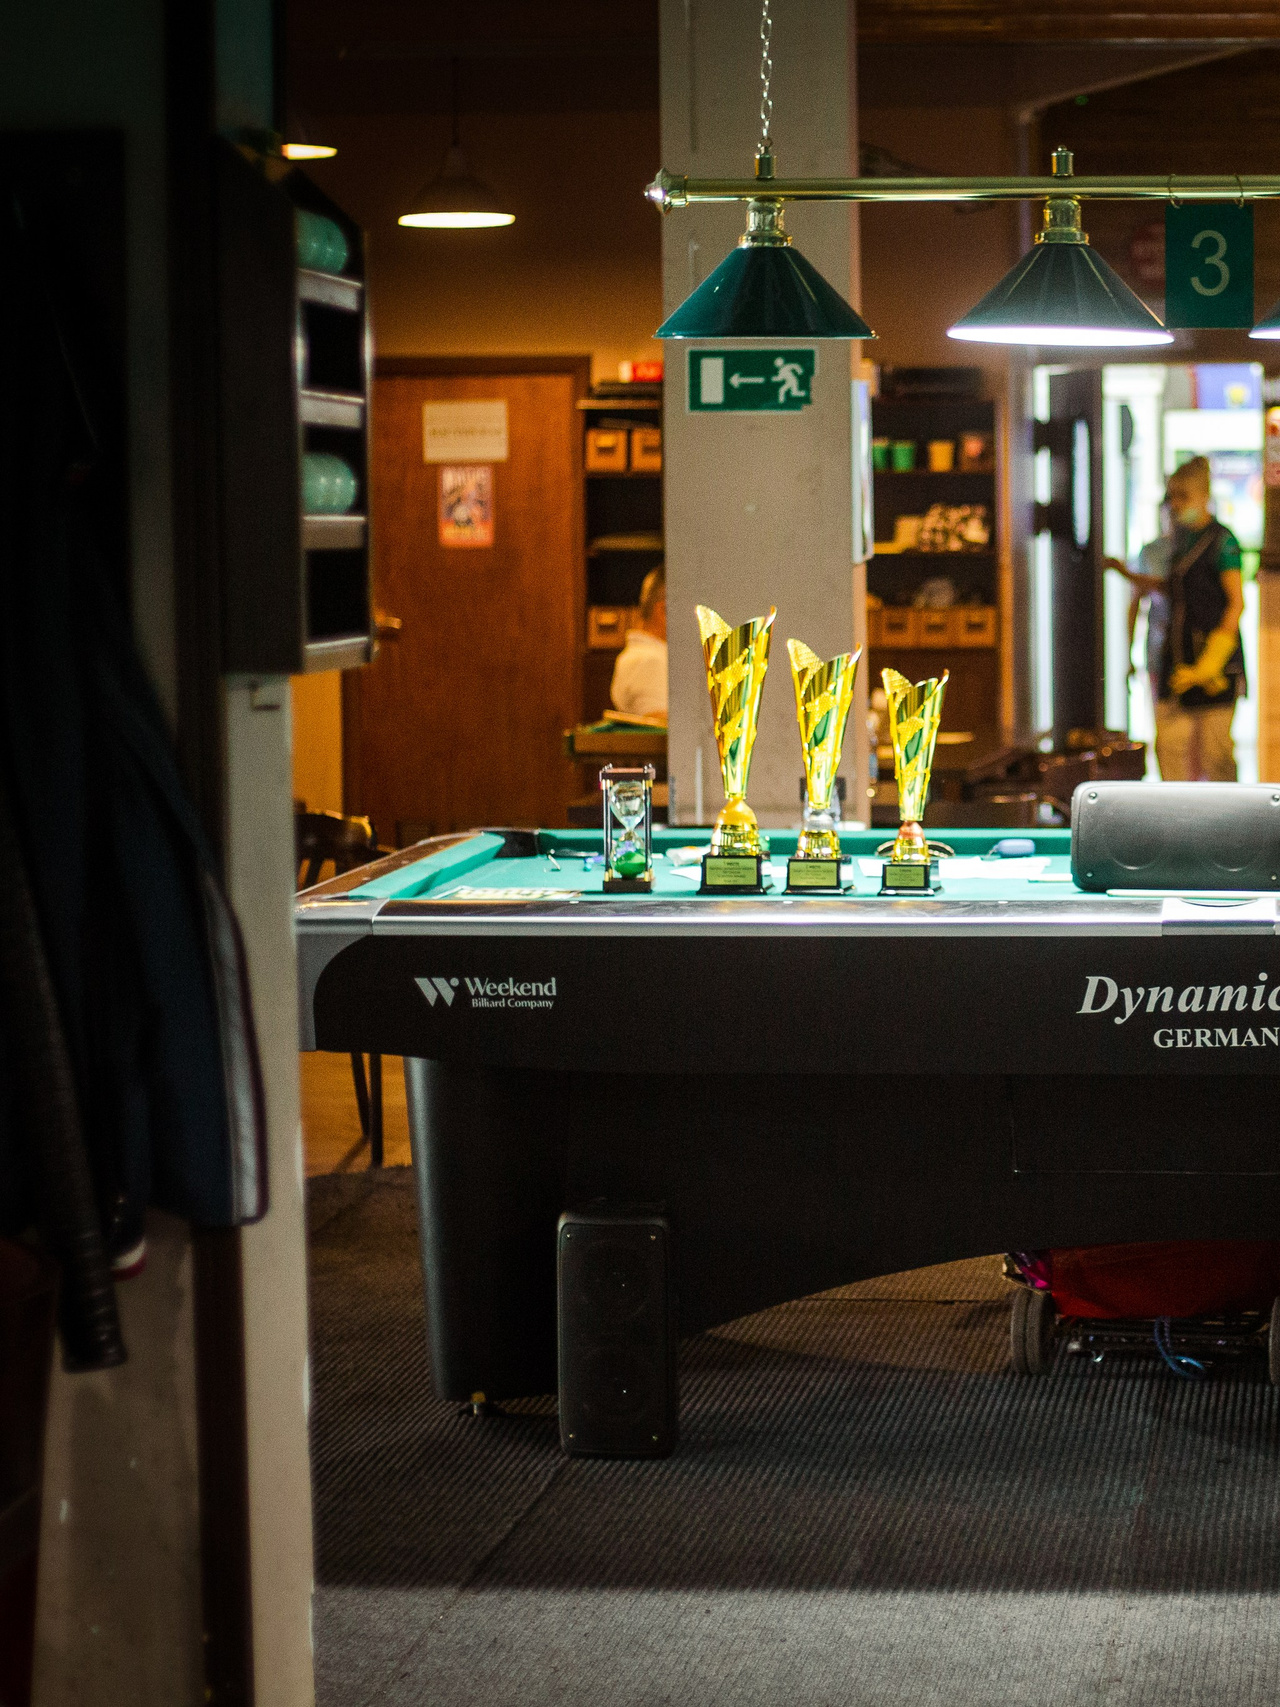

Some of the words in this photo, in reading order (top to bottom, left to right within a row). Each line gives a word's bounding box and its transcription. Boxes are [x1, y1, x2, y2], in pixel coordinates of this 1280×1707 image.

[1190, 229, 1230, 297] 3
[464, 976, 557, 996] Weekend
[471, 997, 506, 1009] Billiard
[507, 998, 555, 1010] Company
